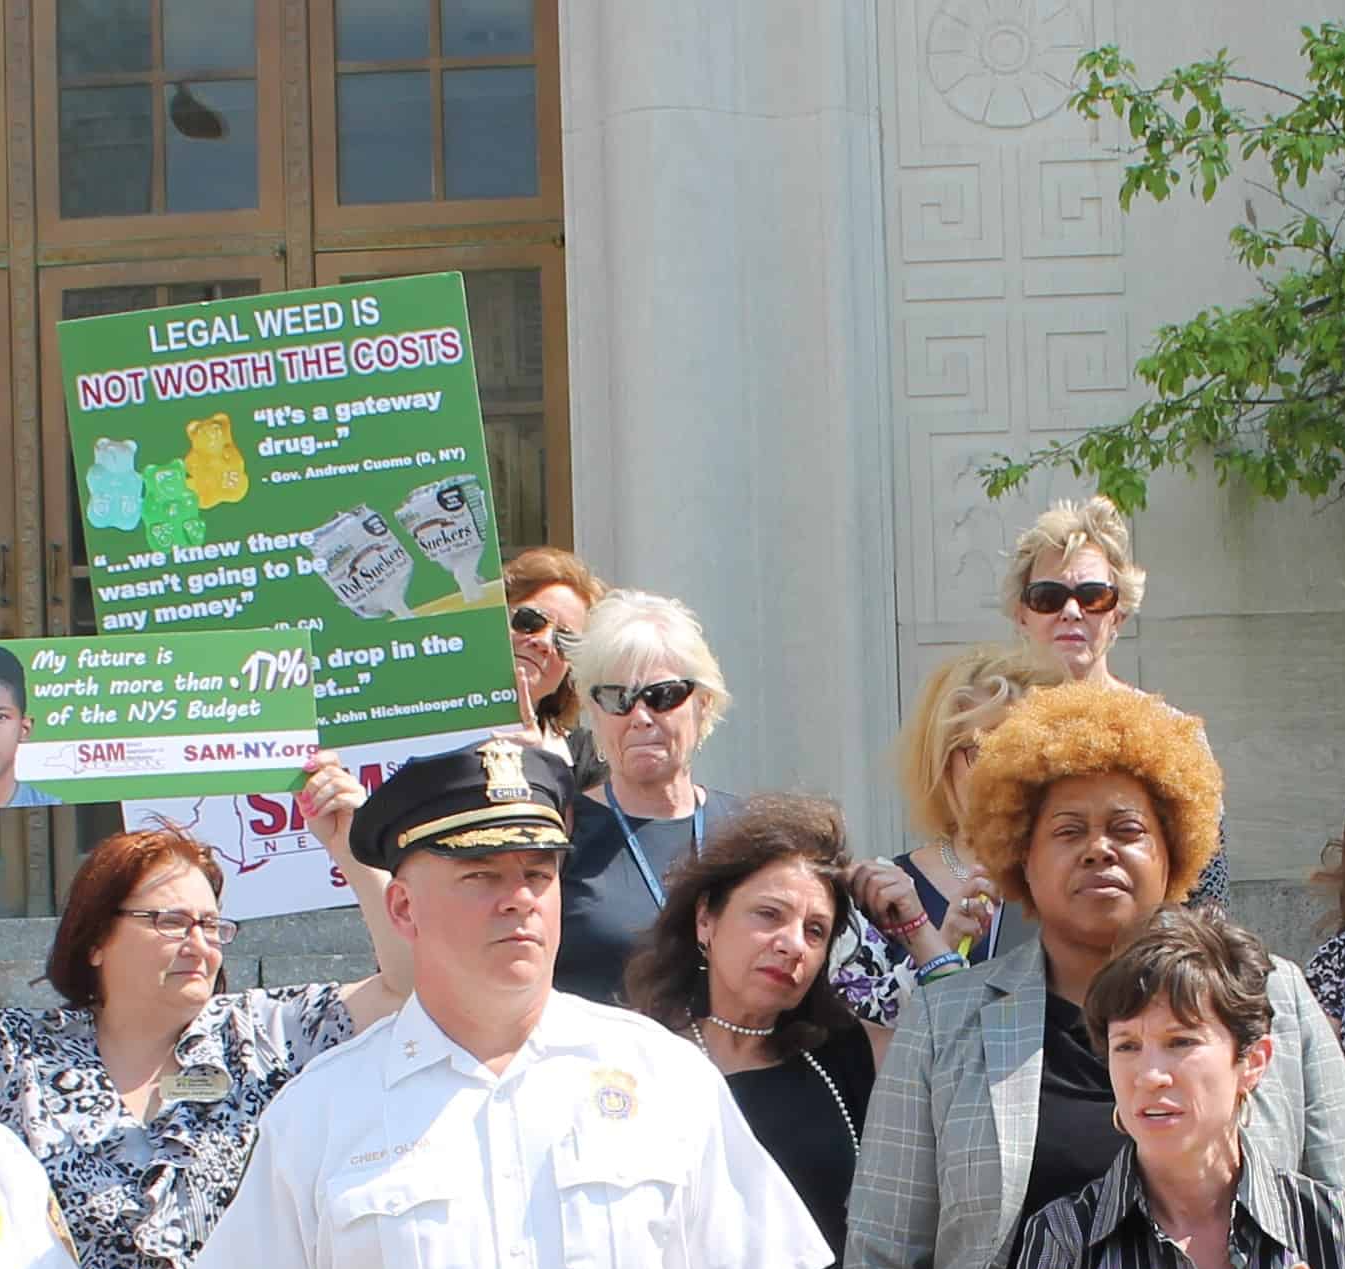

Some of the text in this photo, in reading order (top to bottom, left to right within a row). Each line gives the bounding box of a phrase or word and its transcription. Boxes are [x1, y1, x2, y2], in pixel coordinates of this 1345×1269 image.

[149, 297, 380, 353] LEGAL WEED IS
[80, 331, 461, 408] NOT WORTH THE COSTS
[313, 406, 328, 421] a
[335, 391, 442, 424] gateway
[271, 468, 302, 484] Gov.
[305, 461, 359, 480] Andrew
[363, 457, 412, 473] Cuomo
[416, 453, 435, 470] (D,
[439, 447, 466, 464] NY)
[173, 538, 240, 565] knew
[248, 531, 316, 553] there
[189, 566, 257, 595] going
[263, 559, 289, 579] to
[297, 555, 329, 575] be
[102, 609, 148, 631] any
[31, 647, 173, 674] My future is
[328, 647, 385, 668] drop
[391, 640, 416, 660] in
[421, 635, 463, 655] the
[34, 677, 99, 698] worth
[110, 678, 164, 696] more
[174, 671, 223, 691] than
[47, 699, 262, 727] of the NYS Budget
[333, 710, 367, 725] John
[370, 697, 464, 720] Hickenlooper
[467, 692, 488, 709] (D,
[490, 687, 517, 702] CO)
[78, 742, 125, 763] SAM
[184, 741, 320, 762] SAM-NY.org
[265, 836, 307, 852] NE
